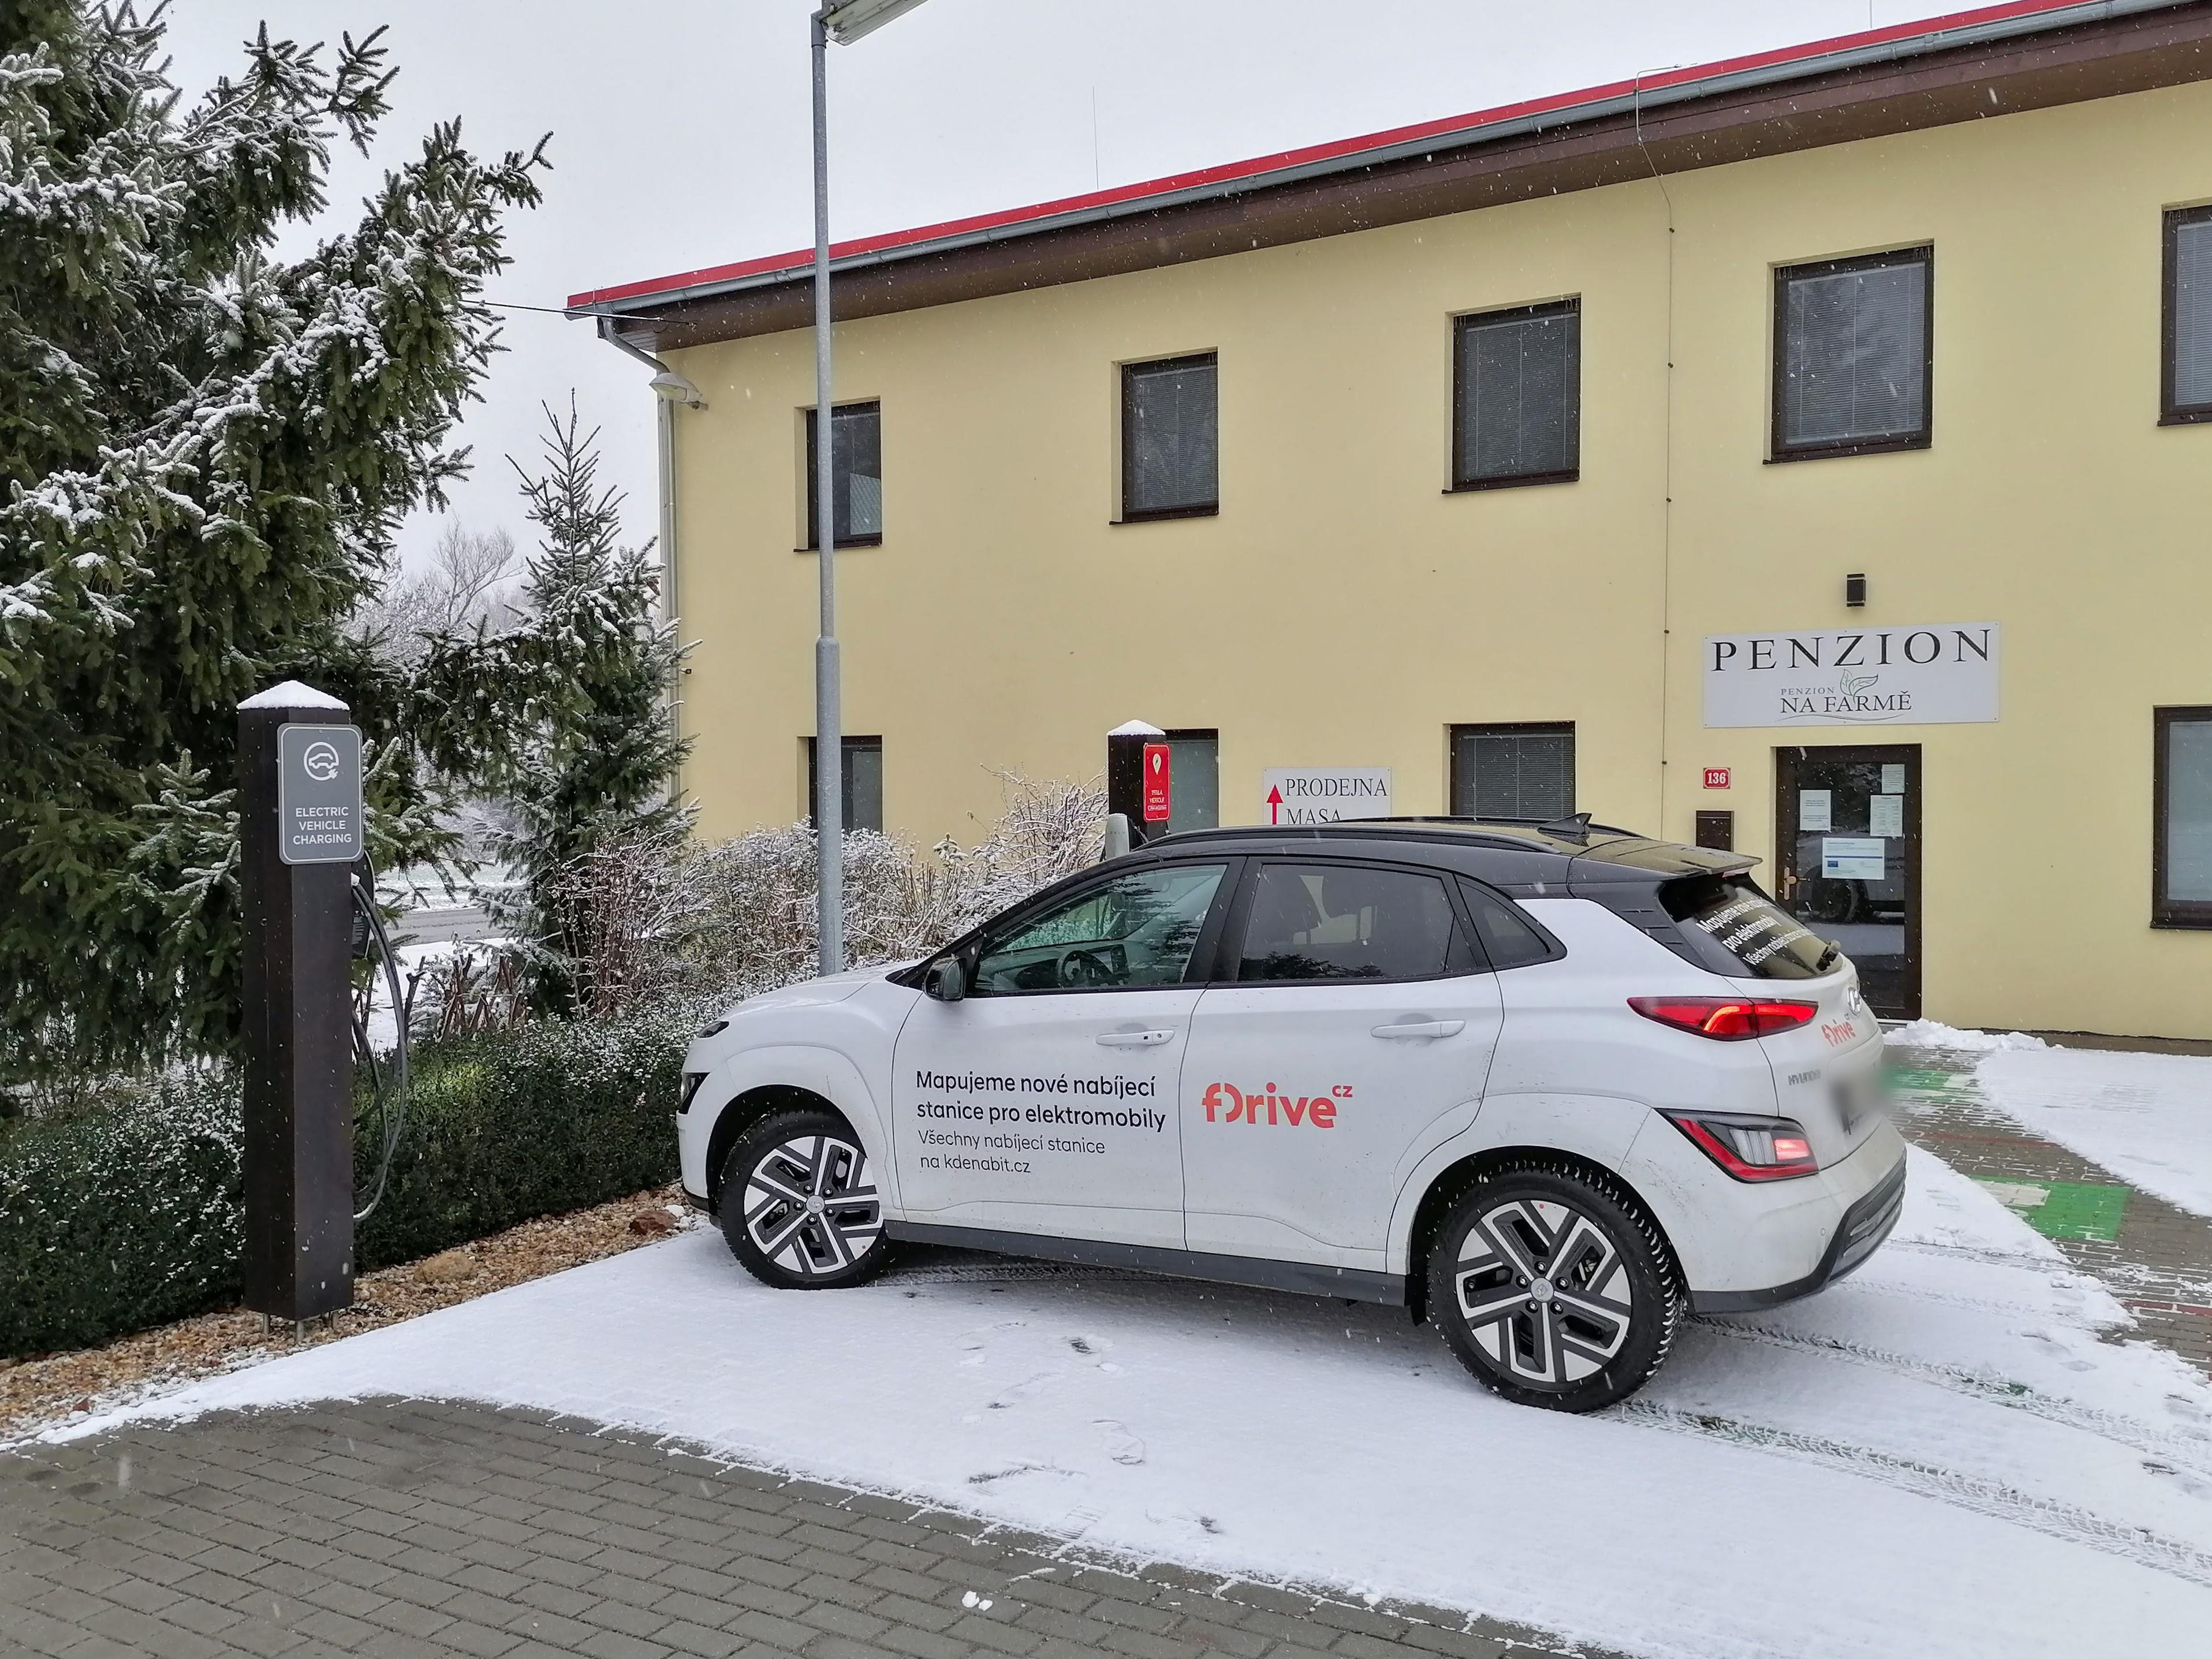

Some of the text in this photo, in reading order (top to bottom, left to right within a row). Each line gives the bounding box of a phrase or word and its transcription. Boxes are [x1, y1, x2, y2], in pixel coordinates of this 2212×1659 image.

[1711, 628, 1992, 672] PENZION
[1781, 687, 1835, 696] PENZION
[1780, 691, 1912, 714] NA FARMĚ
[1285, 778, 1389, 797] PRODEJNA
[1707, 772, 1726, 784] 136
[296, 807, 349, 817] ELECTRIC
[1286, 808, 1344, 825] MASA
[298, 820, 346, 831] VEHICLE
[293, 833, 352, 845] CHARGING
[916, 1071, 1156, 1100] Mapujeme nové nabíjecí
[917, 1100, 1166, 1133] stanice pro elektromobily
[918, 1129, 1105, 1154] Všechny nabíjecí stanice
[920, 1154, 1031, 1173] na kdenabit.cz
